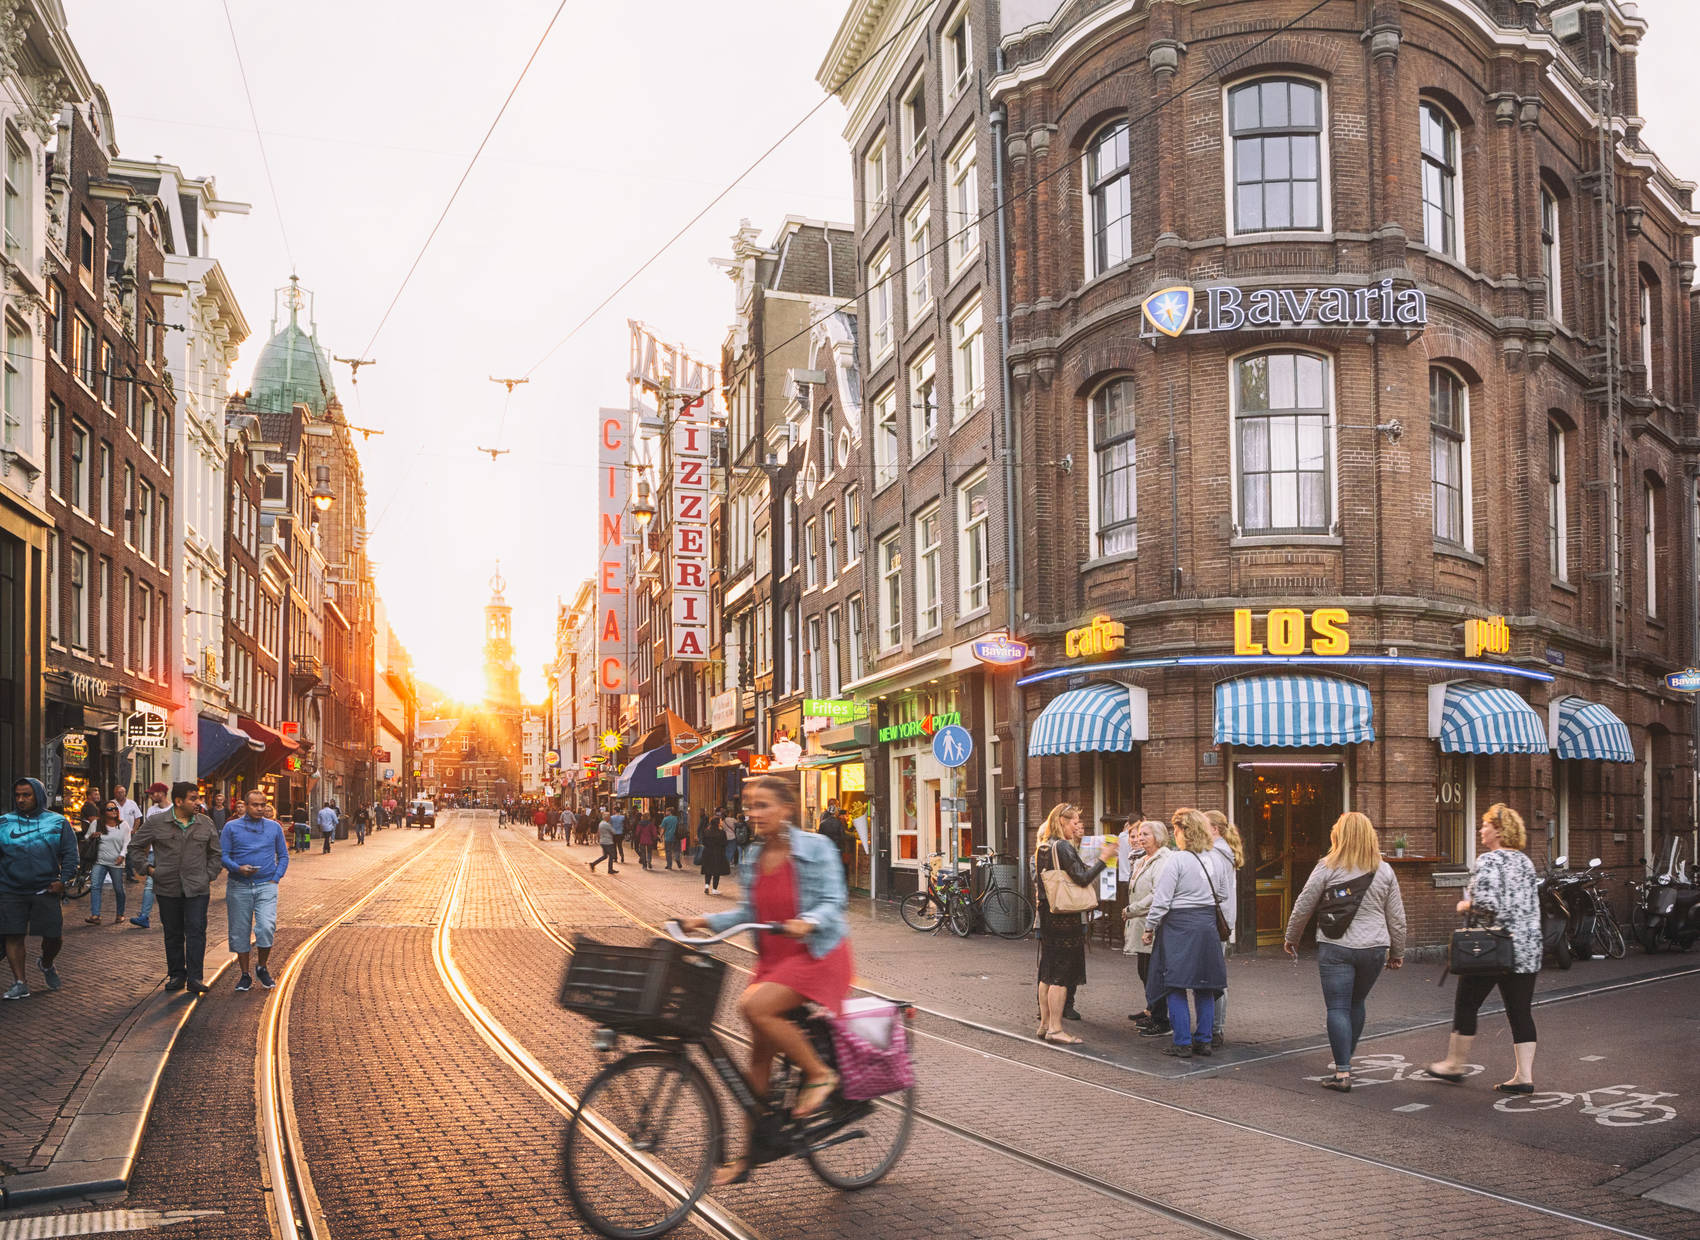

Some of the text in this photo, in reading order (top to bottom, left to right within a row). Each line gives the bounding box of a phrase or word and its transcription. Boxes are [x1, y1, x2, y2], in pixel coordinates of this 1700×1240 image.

[1207, 278, 1427, 331] Bavaria
[677, 396, 706, 655] PIZZERIA
[602, 418, 621, 690] CINEAC
[1234, 608, 1350, 656] LOS
[1467, 615, 1510, 657] pub
[981, 646, 1022, 658] Bavaria
[72, 672, 108, 703] TATTOO
[812, 701, 848, 715] Frites
[879, 711, 961, 743] NEW YORK PIZZA
[1435, 781, 1462, 804] OS
